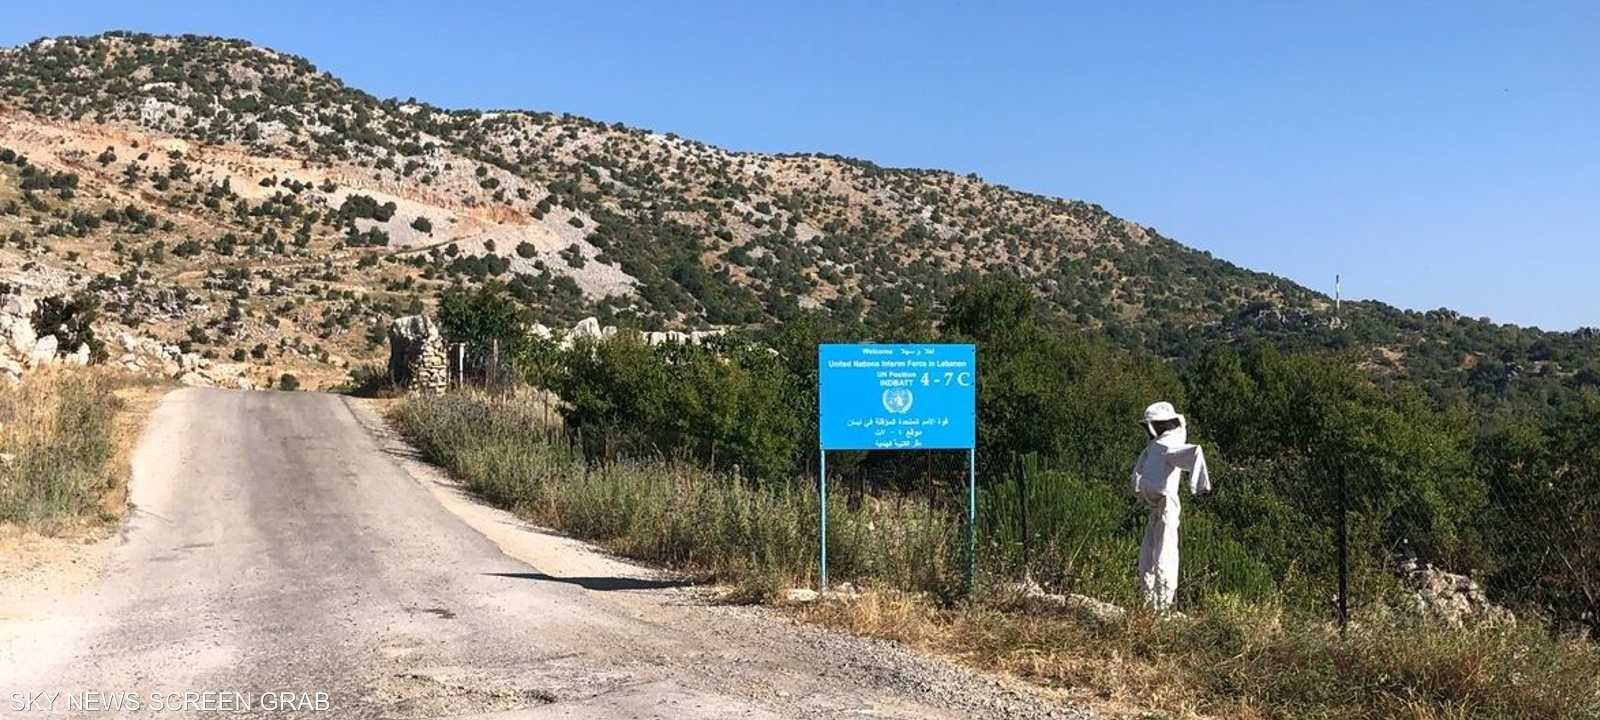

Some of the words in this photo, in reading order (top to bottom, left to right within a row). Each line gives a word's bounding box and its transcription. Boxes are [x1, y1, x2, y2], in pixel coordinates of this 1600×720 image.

[828, 360, 852, 368] United
[853, 360, 880, 368] Nations
[907, 360, 927, 368] Force
[928, 360, 936, 368] in
[936, 360, 967, 368] Lebanon
[880, 379, 913, 387] INDBATT
[920, 372, 929, 386] 4
[944, 372, 954, 386] 7
[957, 372, 971, 386] C
